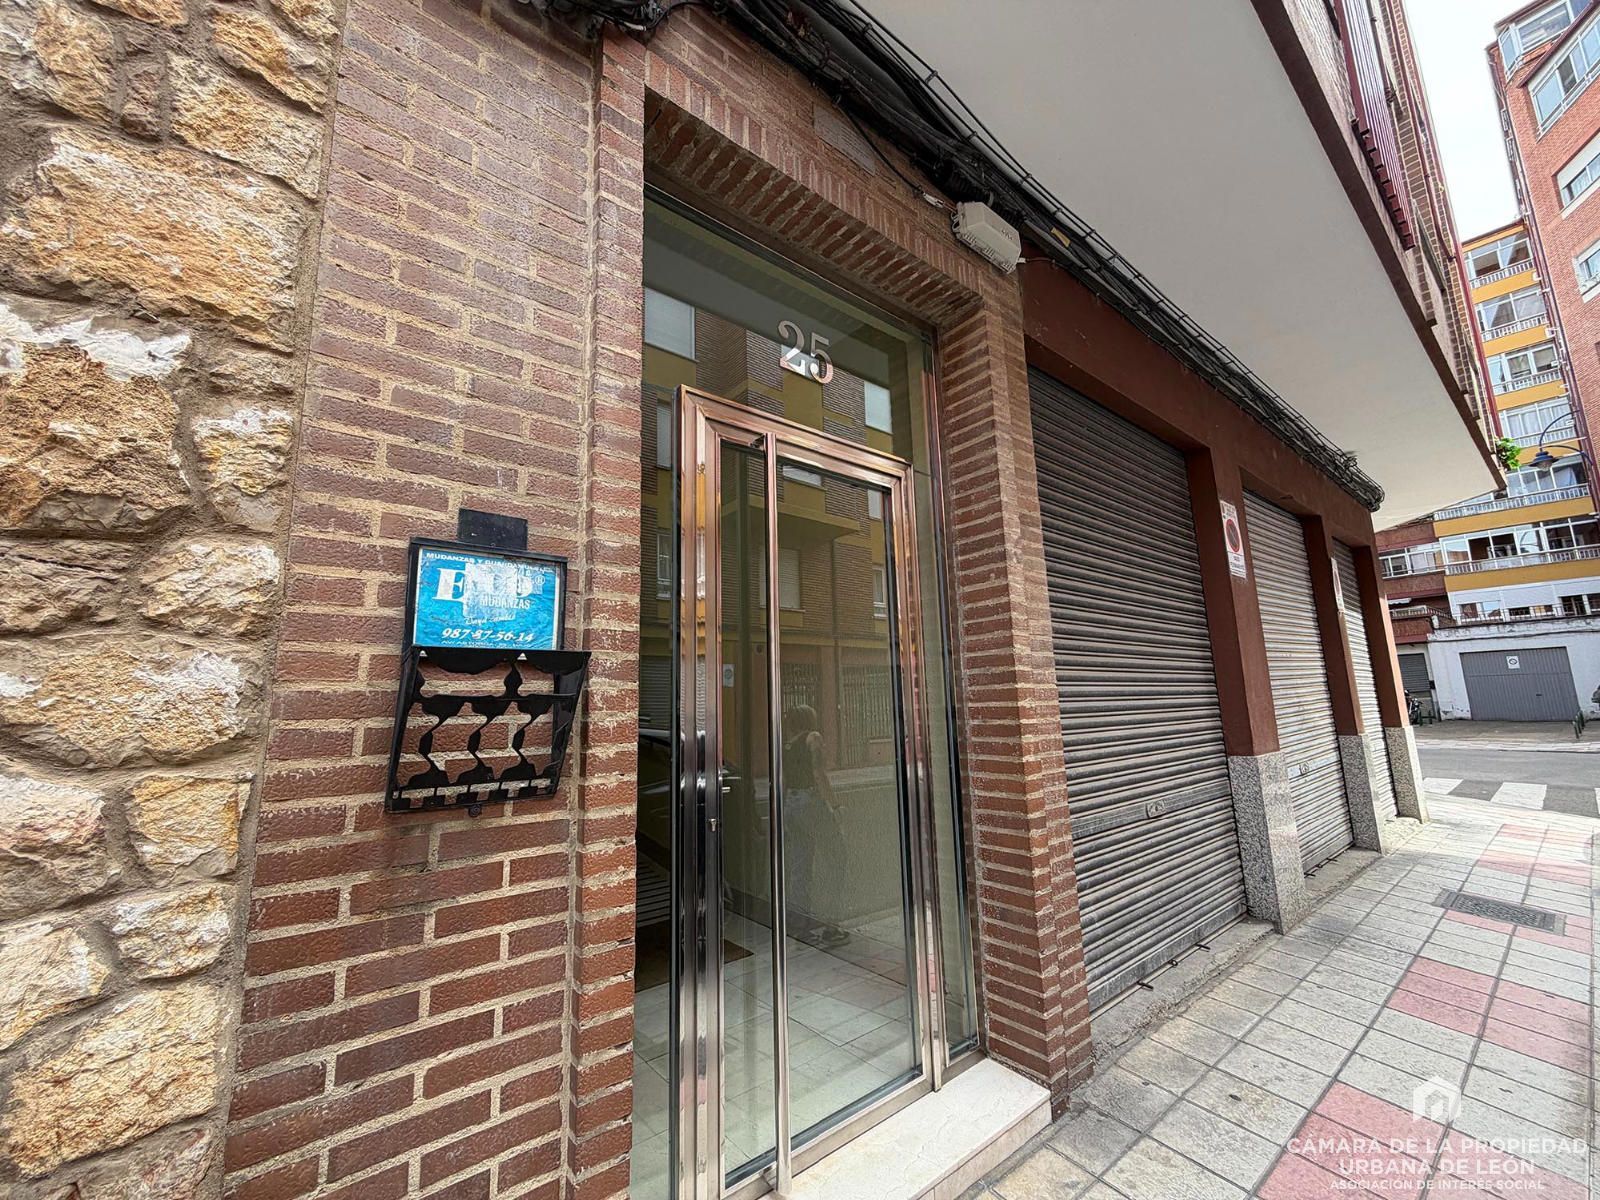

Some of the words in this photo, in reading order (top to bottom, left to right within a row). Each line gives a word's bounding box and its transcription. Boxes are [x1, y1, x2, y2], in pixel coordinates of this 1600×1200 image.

[778, 320, 834, 384] 25
[425, 552, 475, 564] MUDANZAS
[479, 596, 531, 610] MUDANZAS
